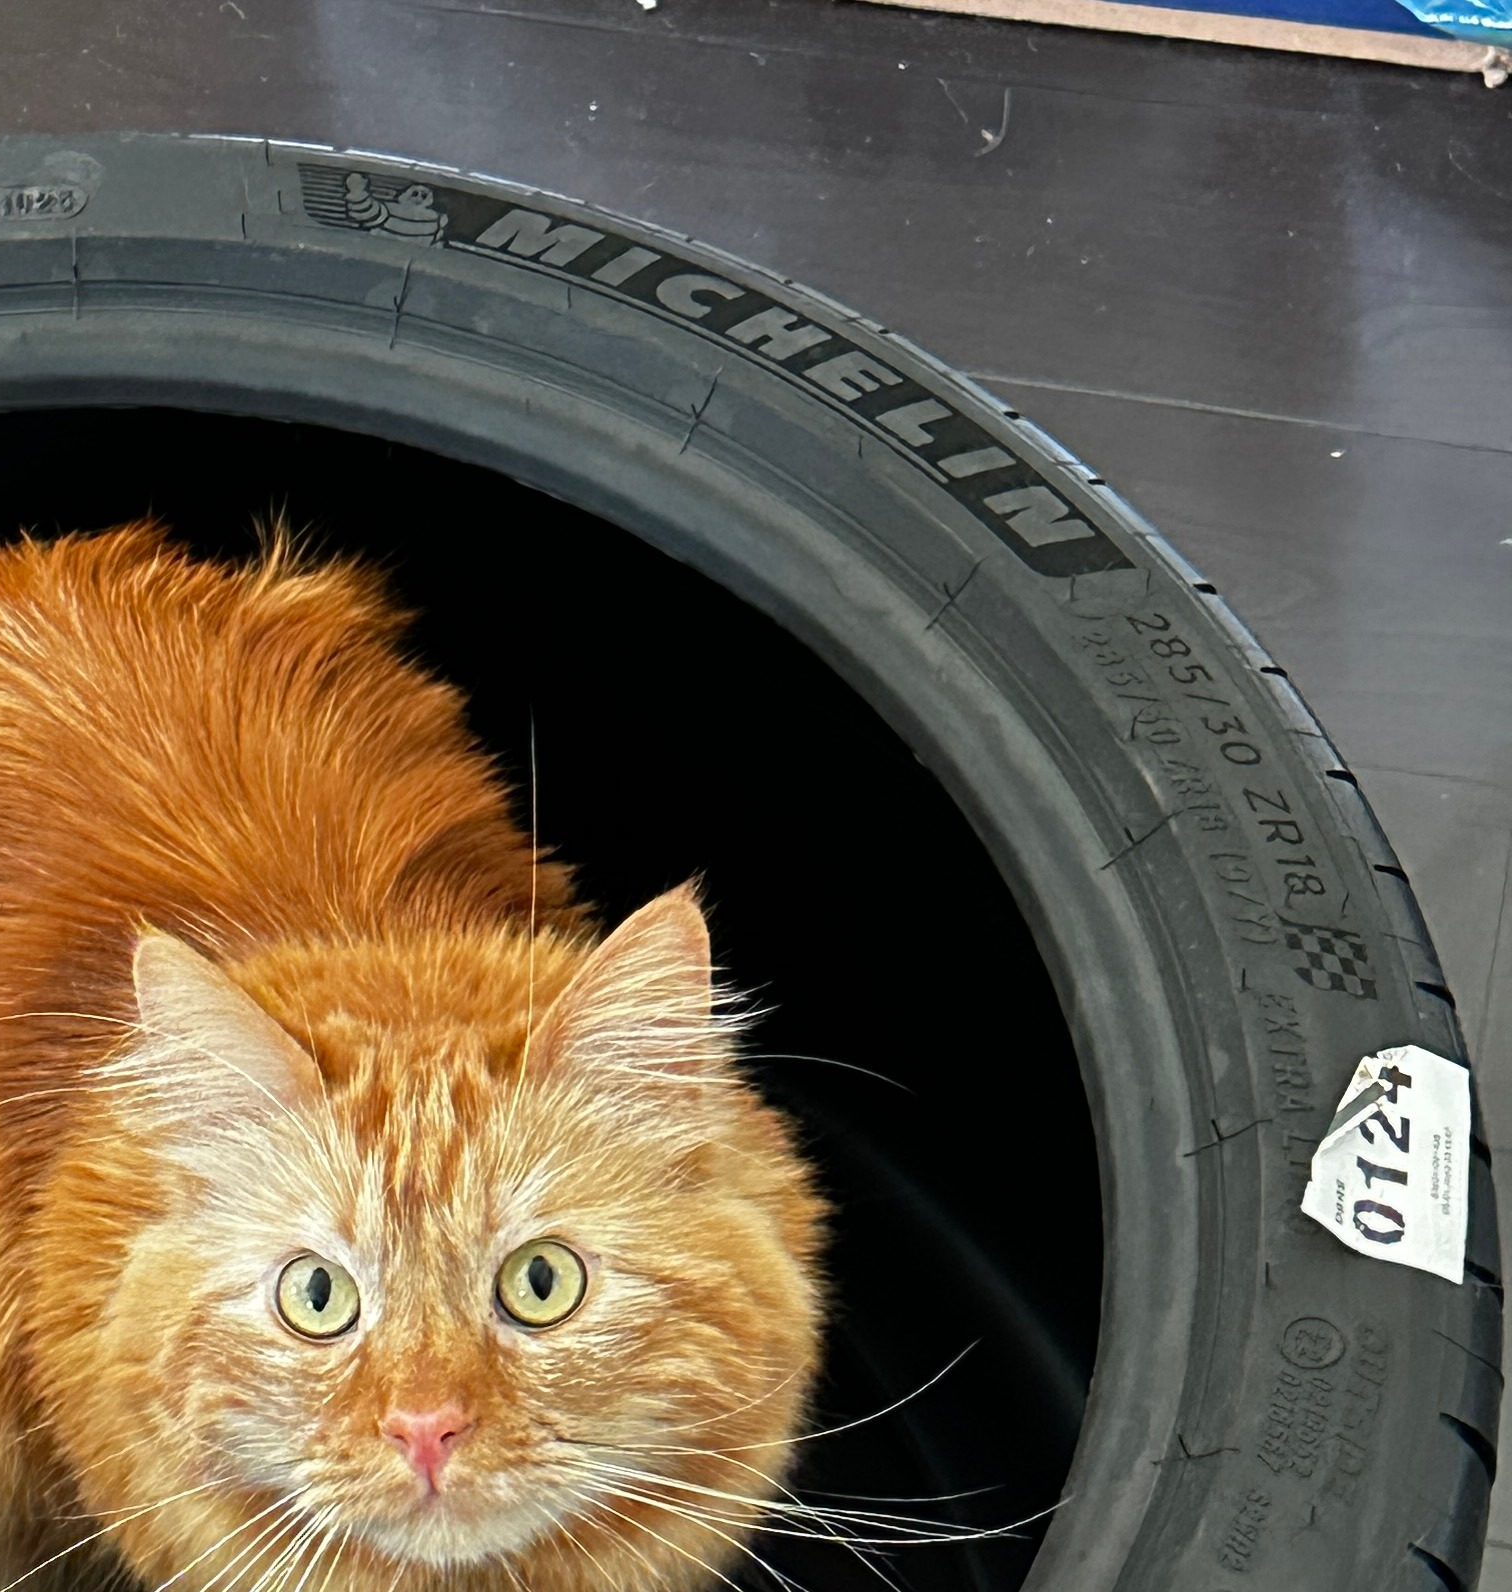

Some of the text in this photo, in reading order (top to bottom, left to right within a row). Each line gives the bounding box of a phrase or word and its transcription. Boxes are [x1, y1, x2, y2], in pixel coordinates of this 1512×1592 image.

[473, 207, 1098, 549] MICHELIN
[1122, 611, 1328, 900] 285/30 ZR18
[1252, 994, 1315, 1116] EXTRA
[1349, 1063, 1413, 1243] 0124
